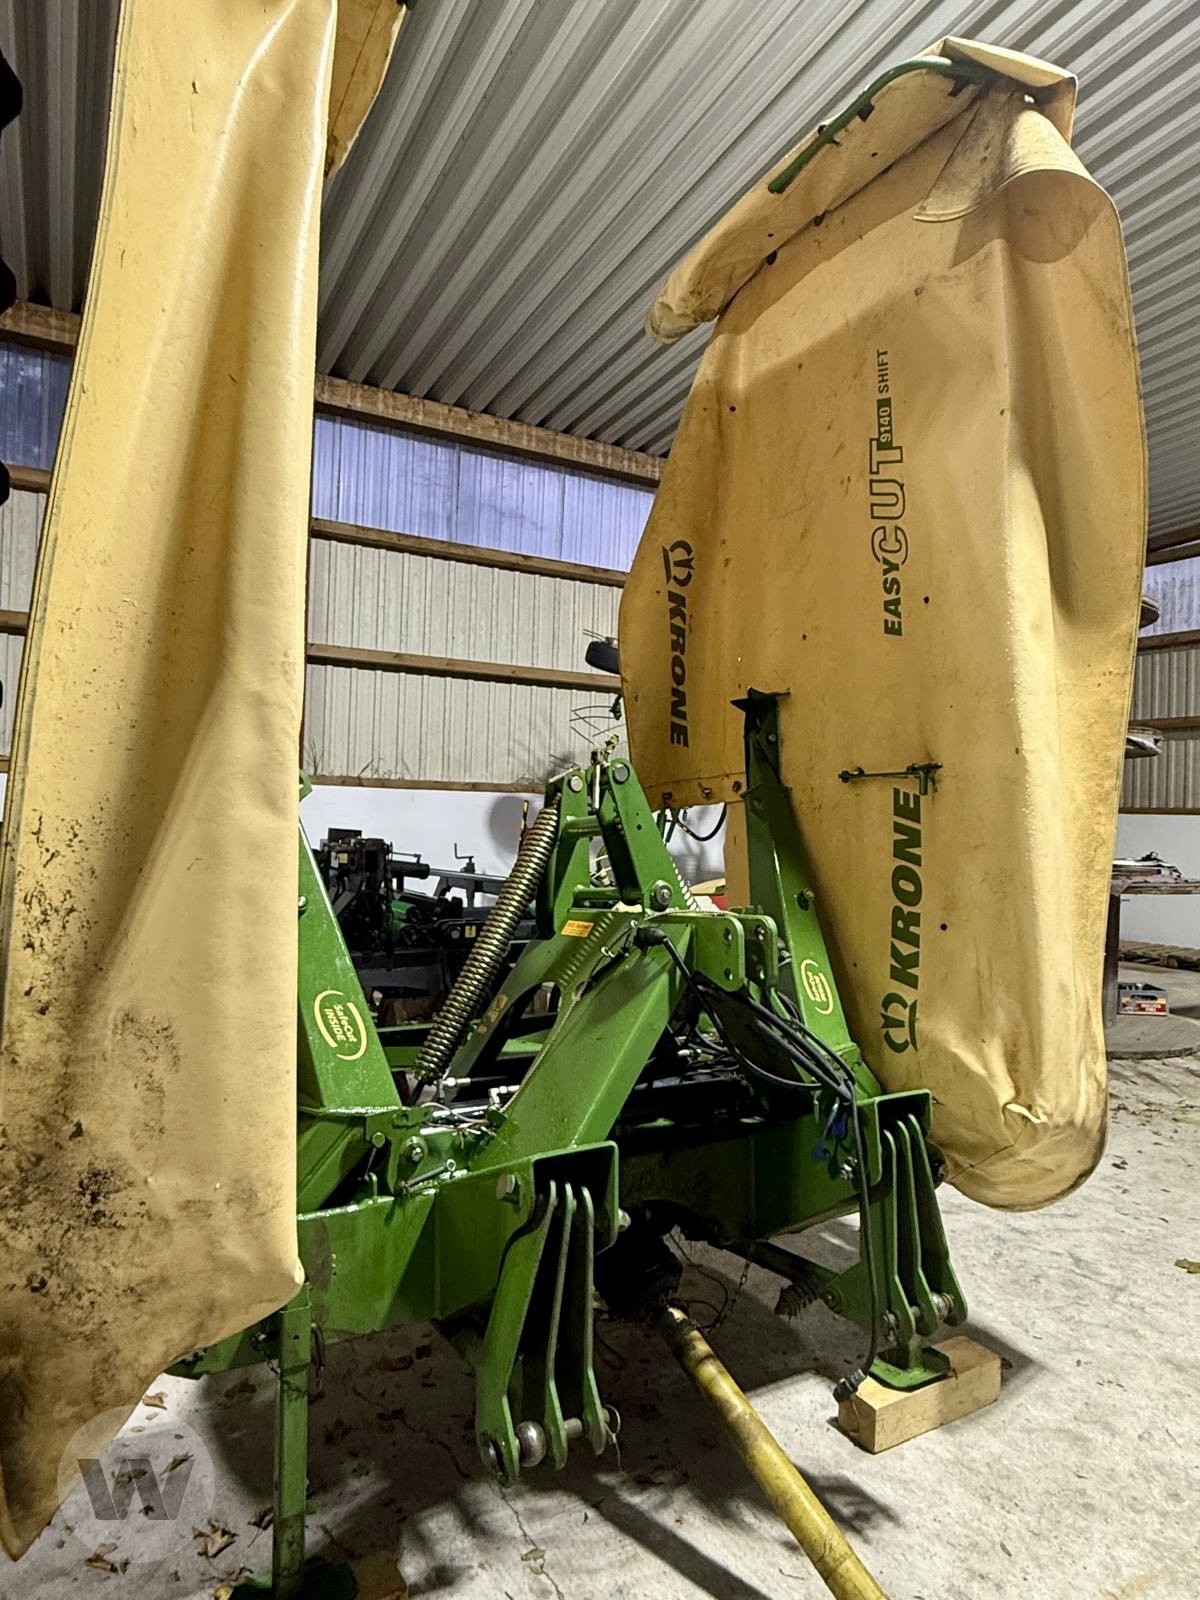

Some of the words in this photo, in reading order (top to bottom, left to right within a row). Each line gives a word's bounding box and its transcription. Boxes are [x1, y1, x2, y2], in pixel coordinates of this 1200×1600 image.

[876, 349, 890, 394] SHIFT
[879, 406, 892, 443] 9140
[667, 590, 689, 748] KRONE
[889, 787, 922, 990] KRONE
[323, 1008, 347, 1041] INSIDE
